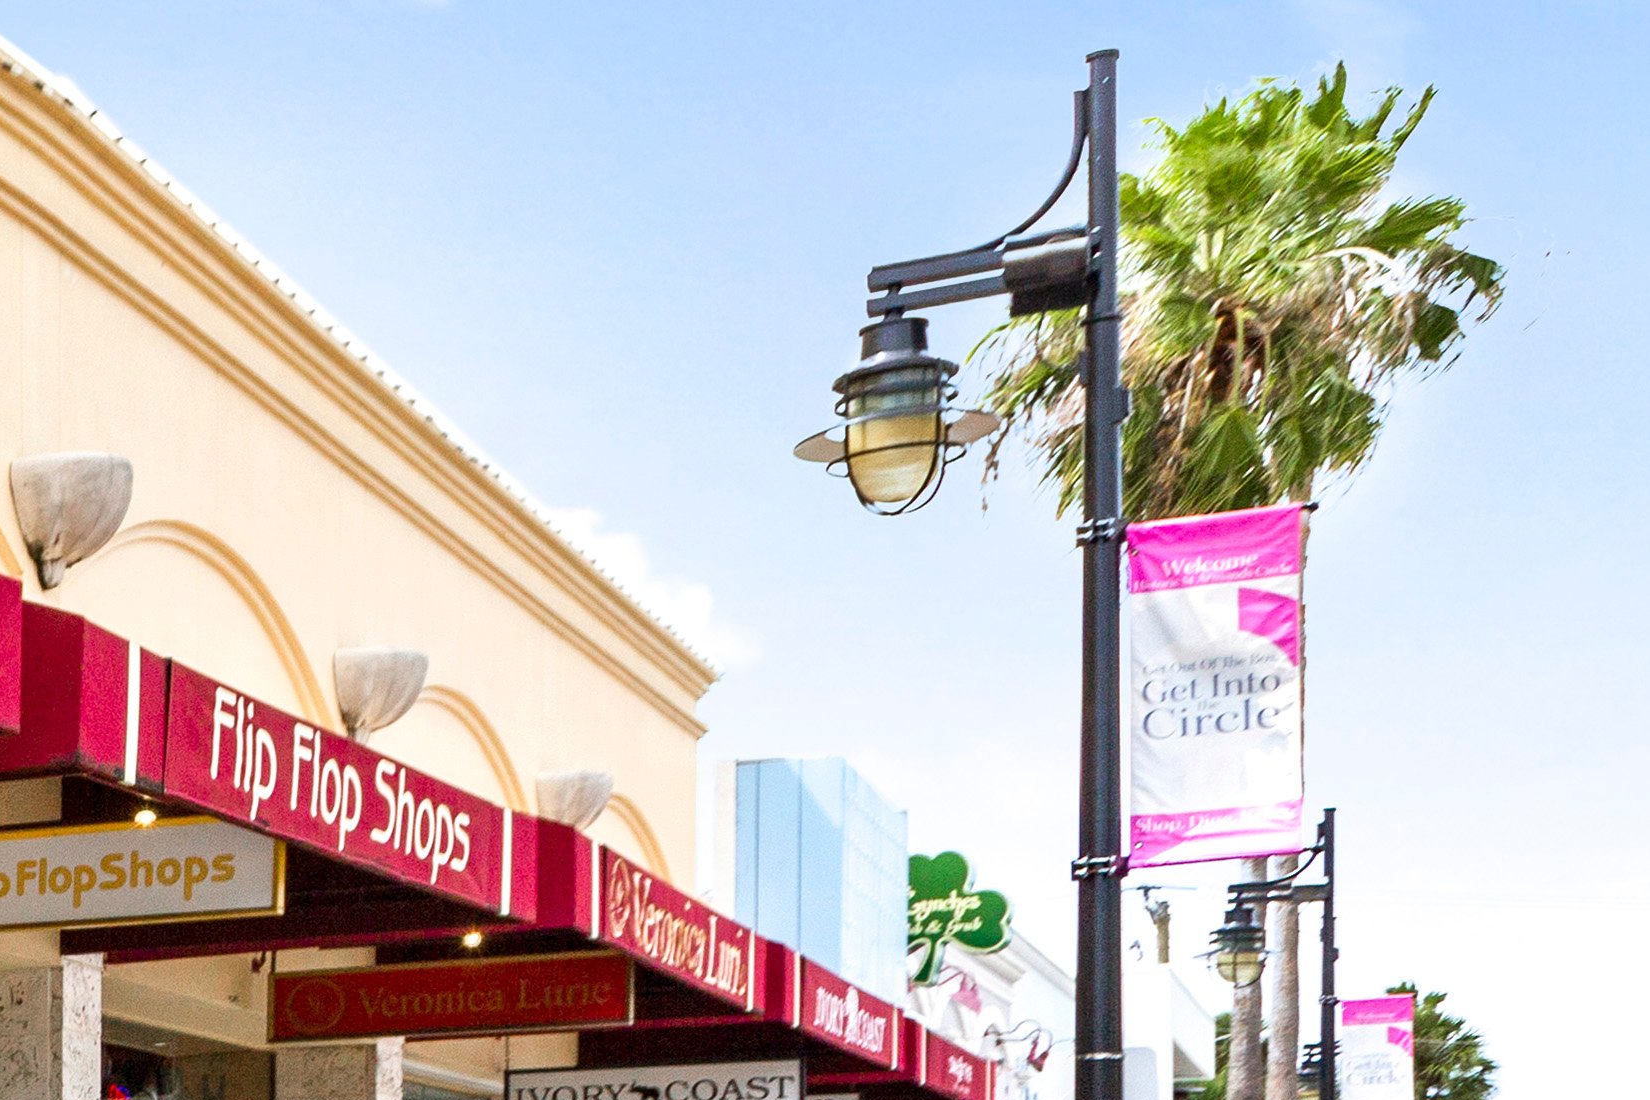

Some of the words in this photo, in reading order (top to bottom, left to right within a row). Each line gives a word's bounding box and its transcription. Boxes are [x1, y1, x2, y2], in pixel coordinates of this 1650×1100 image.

[1161, 553, 1258, 577] Welcome
[1141, 678, 1201, 704] Get
[1211, 672, 1281, 698] Into
[1142, 698, 1281, 741] Circle
[210, 686, 277, 821] Flip
[290, 722, 362, 852] Flop
[370, 758, 470, 885] Shops
[633, 870, 708, 979] Veronica
[358, 981, 503, 1018] Veronica
[518, 977, 612, 1011] Lurie
